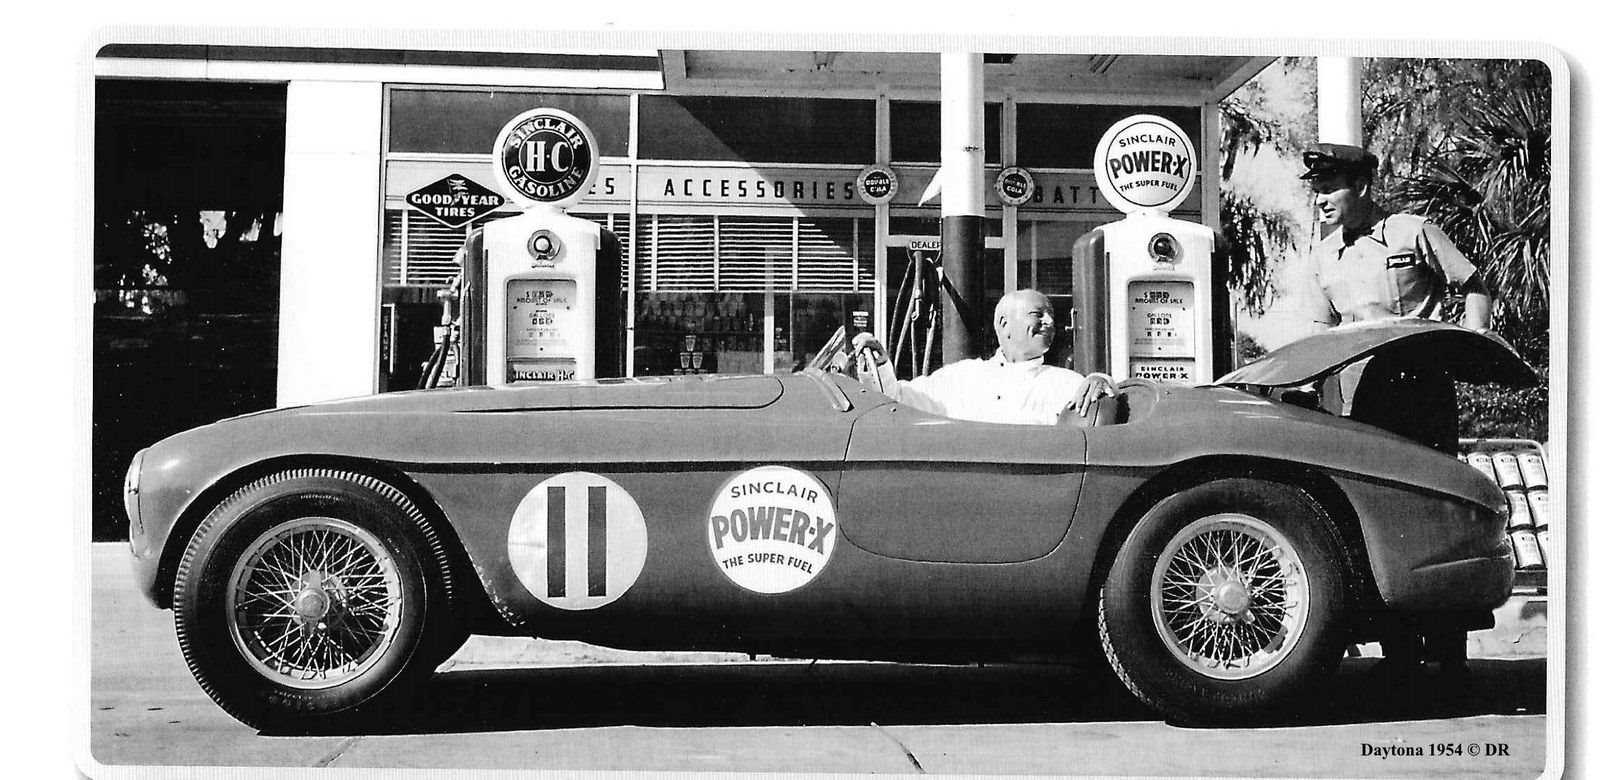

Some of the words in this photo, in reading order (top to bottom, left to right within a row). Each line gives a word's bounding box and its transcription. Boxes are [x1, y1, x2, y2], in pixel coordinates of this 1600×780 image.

[508, 118, 585, 150] SINCLAIR
[1118, 134, 1177, 148] SINCLAIR
[508, 165, 585, 198] GASOLINE
[663, 178, 855, 200] ACCESSORIES
[1119, 182, 1134, 192] THE
[1135, 179, 1160, 188] SUPER
[1161, 180, 1178, 191] FUEL
[435, 206, 476, 217] TIRES
[730, 481, 819, 504] SINCLAIR
[547, 486, 607, 598] 11
[722, 555, 744, 570] THE
[747, 553, 785, 565] SUPER
[787, 556, 813, 574] FUEL
